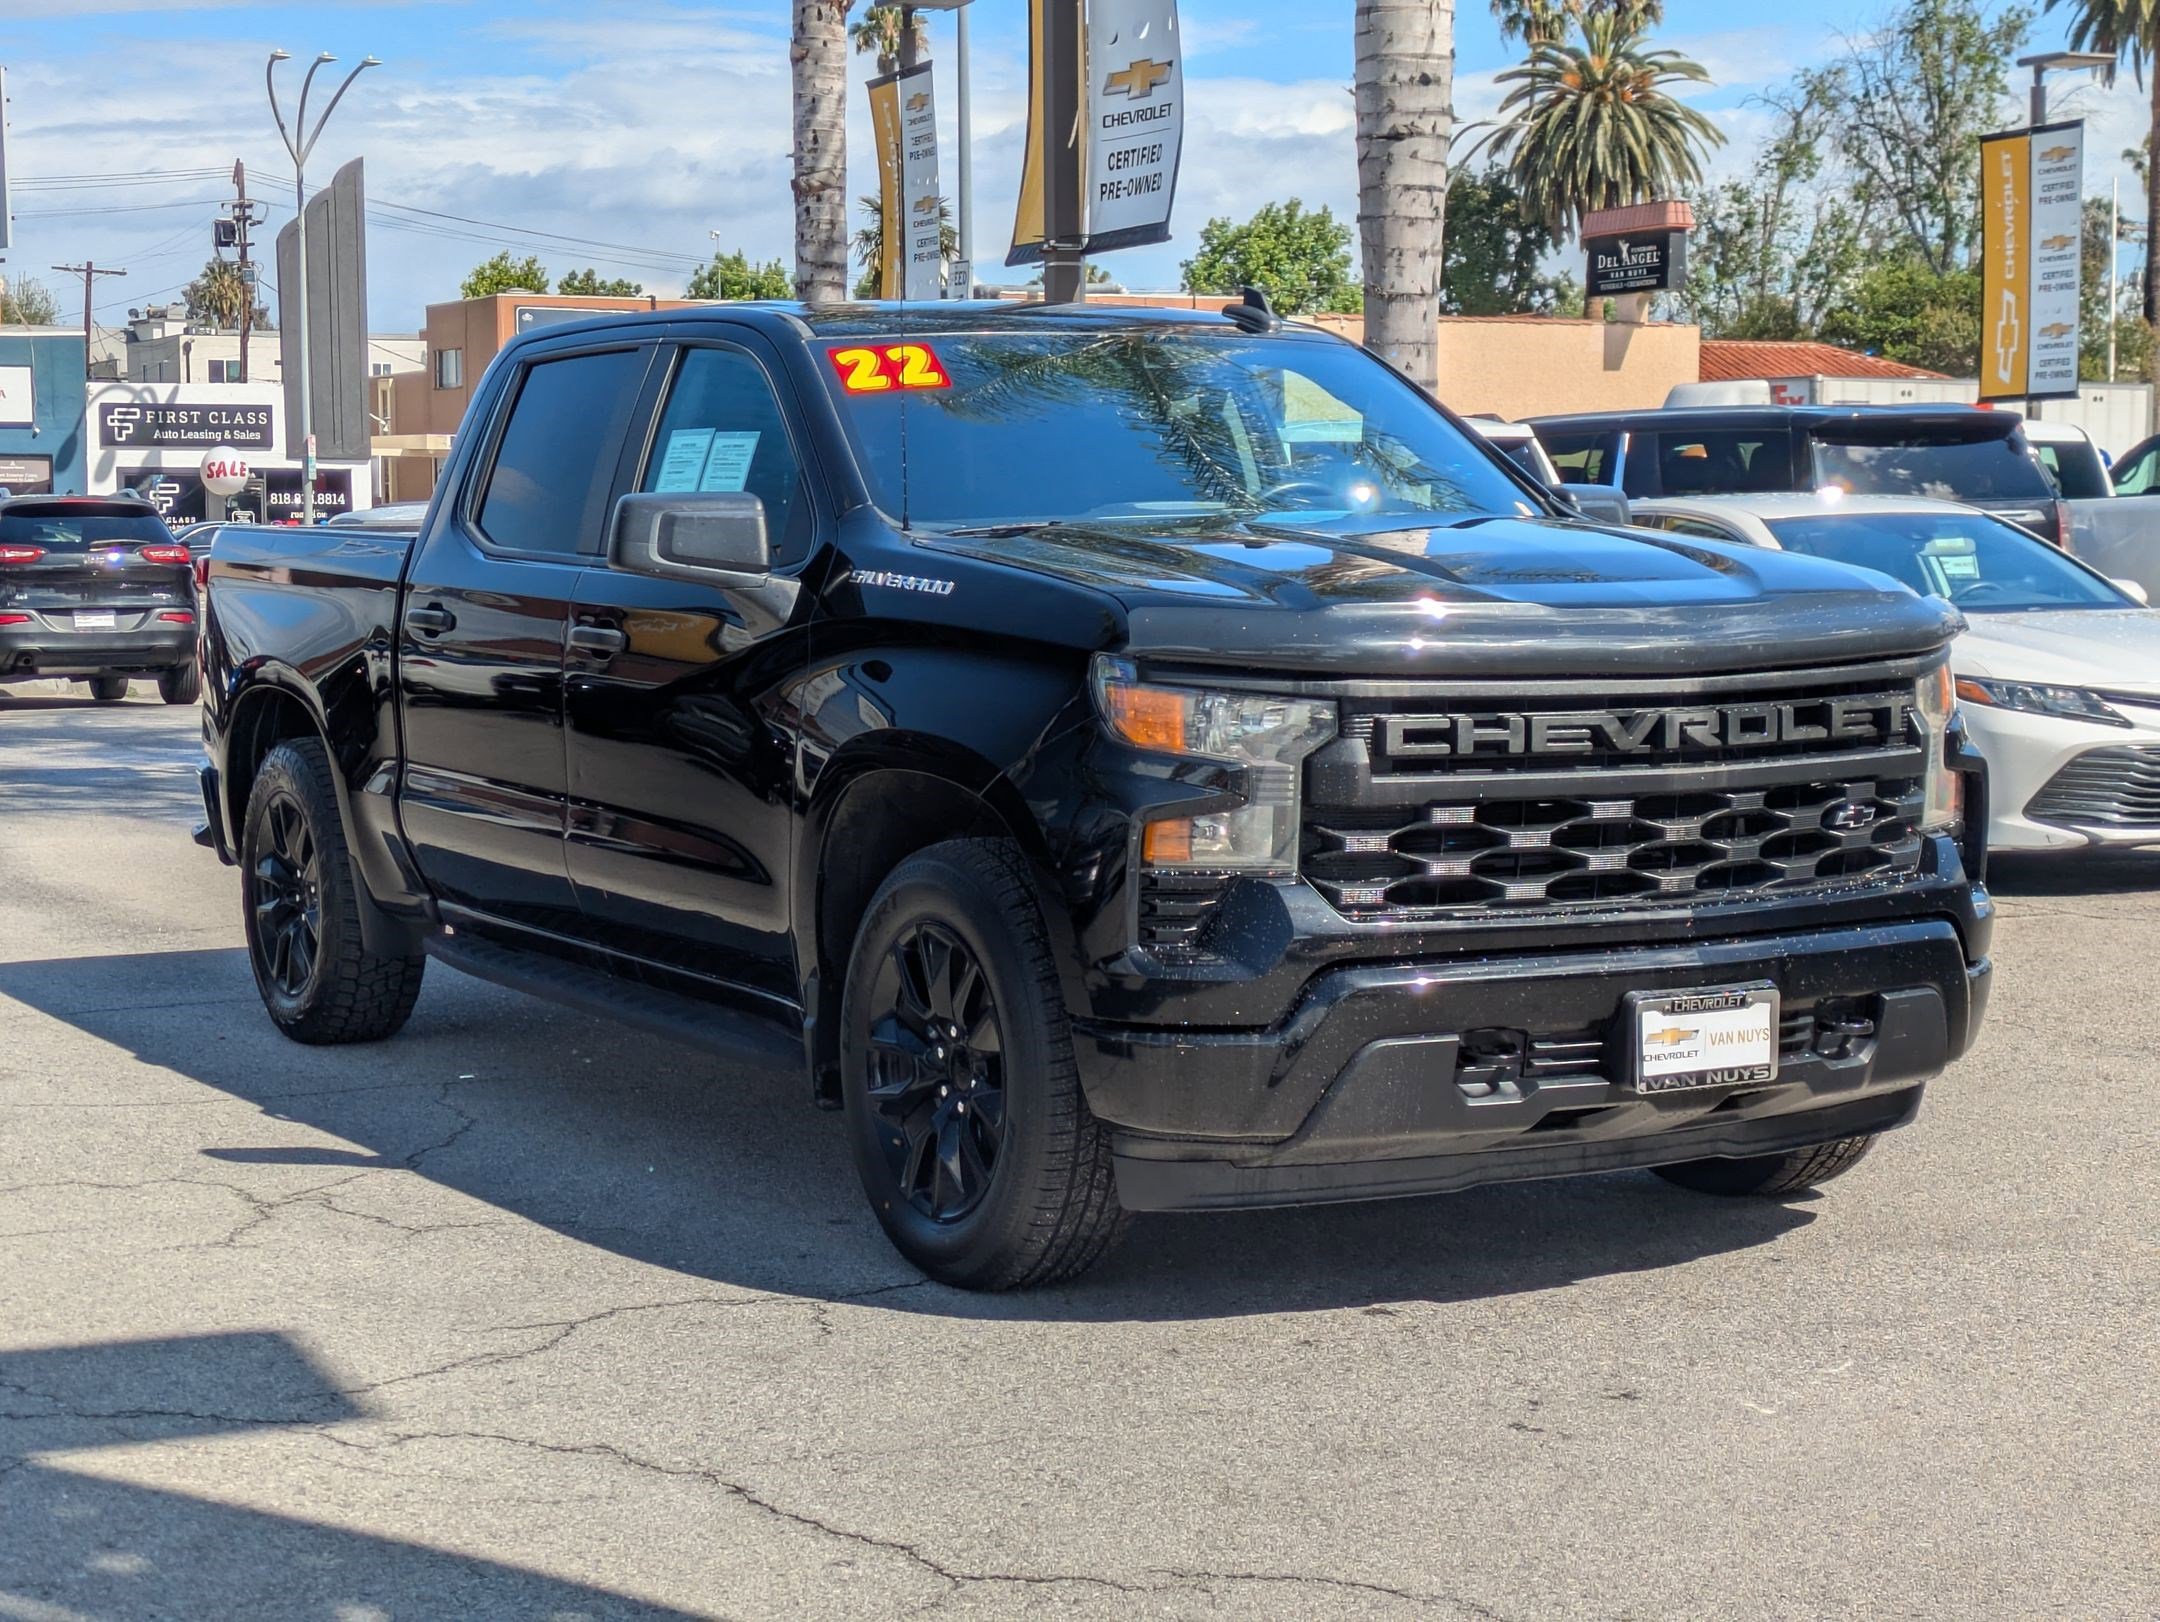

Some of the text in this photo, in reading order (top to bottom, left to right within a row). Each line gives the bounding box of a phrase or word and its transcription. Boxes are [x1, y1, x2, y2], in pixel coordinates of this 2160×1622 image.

[1102, 102, 1173, 129] CHEVROLET
[1107, 143, 1163, 171] CERTIFIED
[1099, 171, 1163, 202] PRE-OWNED
[2002, 151, 2015, 279] CHEVROLET
[1598, 251, 1660, 269] DEL ANGEL
[835, 345, 943, 390] 22
[145, 411, 268, 424] FIRST CLASS
[153, 429, 261, 442] Auto Leasing & Sales
[207, 460, 247, 479] SALE
[849, 569, 955, 595] SILVERADO
[1384, 698, 1908, 756] CHEVROLET
[1673, 994, 1743, 1013] CHEVROLET
[1709, 1027, 1770, 1046] VAN NUYS
[1644, 1049, 1700, 1062] CHEVROLET
[1650, 1065, 1770, 1090] VAN NUYS
